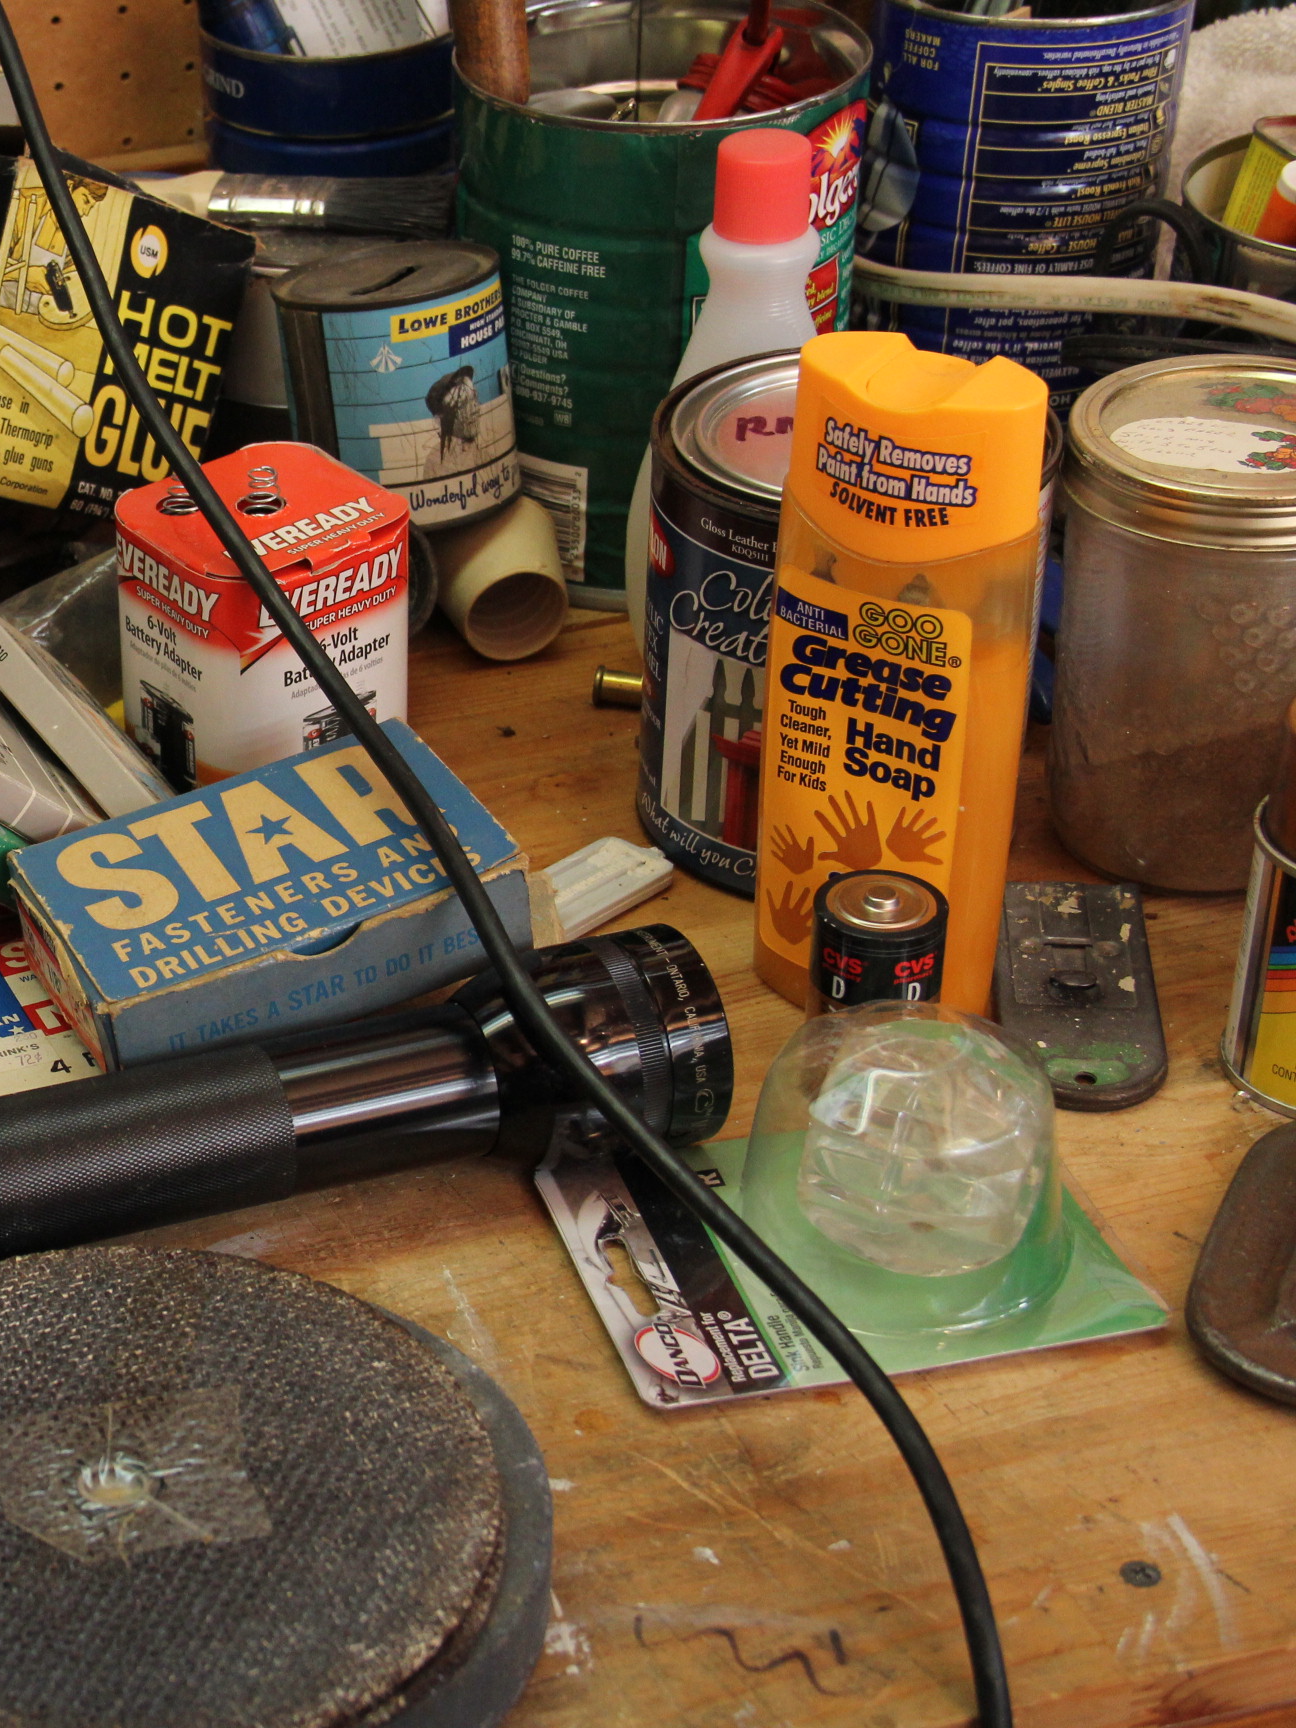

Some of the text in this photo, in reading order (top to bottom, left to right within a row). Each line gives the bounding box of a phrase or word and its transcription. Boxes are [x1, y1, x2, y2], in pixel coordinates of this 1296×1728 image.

[903, 40, 936, 58] COFFEE
[905, 28, 940, 45] MAKERS
[903, 53, 939, 70] FOR ALL
[1077, 77, 1104, 89] Coffee
[1097, 95, 1154, 116] MASTER BLEND
[1064, 128, 1126, 145] Espresso Roast
[1053, 216, 1071, 227] LITE
[140, 245, 159, 259] USM
[512, 235, 599, 263] 100% PURE COFFEE
[537, 256, 579, 275] CAFFEINE
[581, 264, 606, 278] FREE
[974, 260, 1079, 274] FAMILY OF FINE COFFEES:
[118, 290, 233, 357] HOT
[398, 313, 448, 335] LOWE
[460, 325, 492, 349] HOUSE
[553, 318, 588, 333] GAMBLE
[952, 340, 983, 351] coffee
[20, 396, 30, 414] in
[0, 417, 54, 449] Thermogrip
[85, 385, 212, 483] GLUE
[825, 418, 970, 475] Safely Removes
[3, 446, 25, 466] glue
[29, 457, 54, 473] guns
[817, 445, 975, 506] Paint from Hands
[0, 477, 49, 496] Corporation
[409, 472, 479, 511] Wonderful
[482, 473, 503, 499] way
[830, 481, 949, 527] SOLVENT FREE
[223, 496, 376, 558] VEREADY
[287, 512, 386, 555] SUPER HEAVY DUTY
[700, 517, 769, 552] Gloss Leather
[731, 544, 769, 562] KDQ5111
[116, 532, 220, 623] EVEREADY
[136, 585, 209, 640] SUPER HEAVY DUTY
[338, 585, 397, 619] HEAVY DUTY
[796, 601, 825, 620] ANTI
[147, 614, 177, 646] 6-Volt
[780, 606, 846, 639] BACTERIAL
[859, 601, 943, 640] GOO
[125, 615, 203, 682] Battery Adapter
[338, 633, 391, 666] Adapter
[852, 624, 947, 668] GONE
[792, 634, 952, 701] Grease
[780, 663, 957, 743] Cutting
[788, 699, 826, 721] Tough
[781, 714, 832, 740] Cleaner,
[780, 733, 831, 758] Yet Mild
[846, 717, 942, 772] Hand
[780, 749, 826, 775] Enough
[843, 746, 936, 802] Soap
[777, 765, 826, 792] For Kids
[56, 745, 446, 931] STAR
[642, 792, 669, 835] What
[669, 828, 697, 854] will
[700, 848, 731, 869] you
[110, 861, 360, 963] FASTENERS
[128, 910, 308, 990] DRILLING
[823, 947, 863, 975] CVS
[894, 953, 935, 977] CVS
[196, 927, 481, 1045] TAKES A STAR TO DO IT BES
[666, 964, 690, 1001] ONTARIO,
[832, 975, 846, 999] D
[907, 982, 921, 1001] D
[50, 1058, 72, 1074] 4
[1272, 1063, 1296, 1083] CONT
[723, 1317, 780, 1379] DELTA
[766, 1314, 794, 1350] Handle
[653, 1321, 706, 1388] DANCO
[706, 1326, 747, 1383] Replacement
